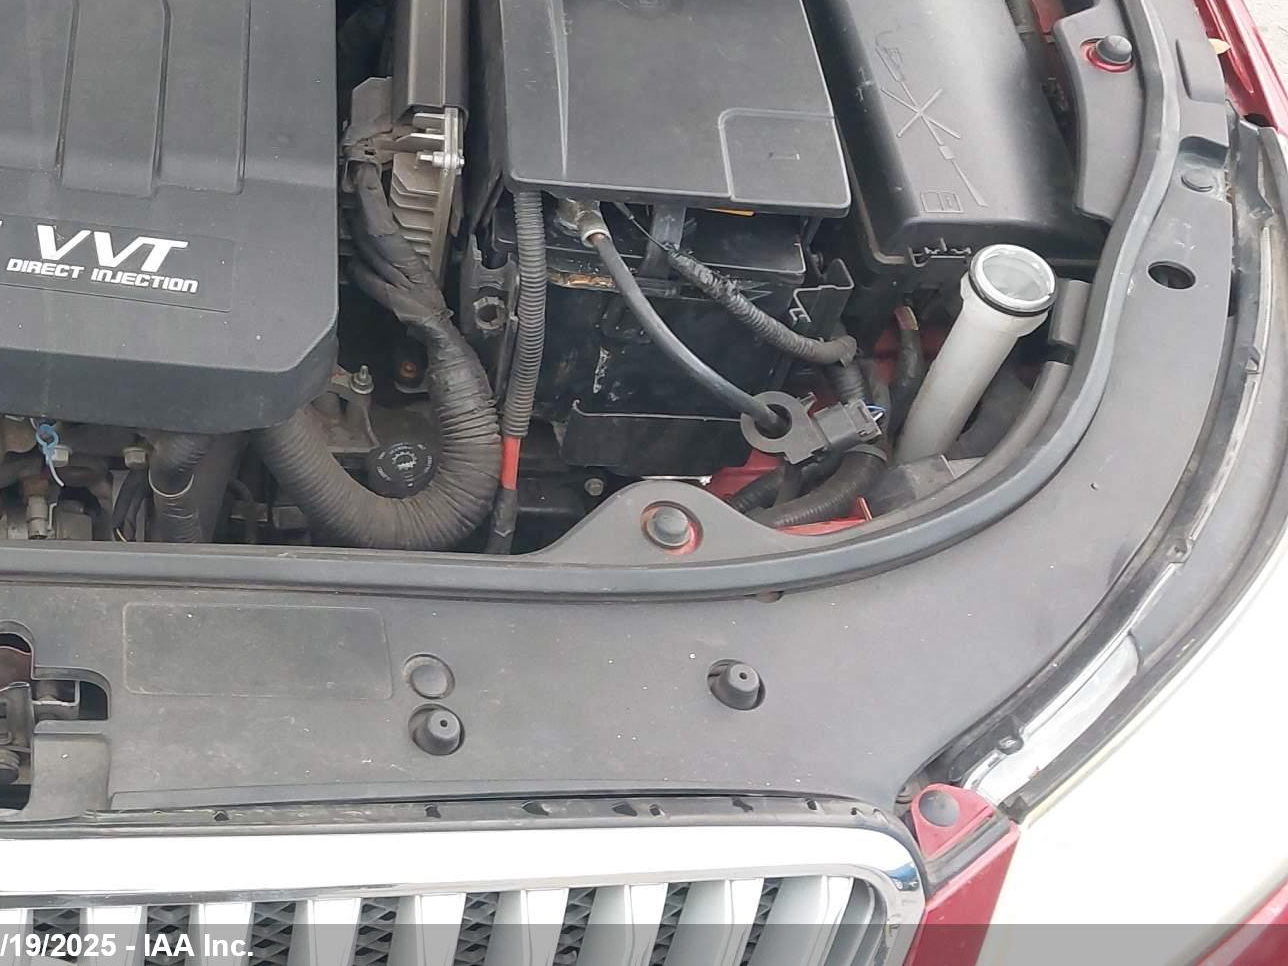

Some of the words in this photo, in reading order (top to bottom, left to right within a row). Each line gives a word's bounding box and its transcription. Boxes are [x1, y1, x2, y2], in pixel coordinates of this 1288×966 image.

[36, 224, 189, 273] VVT
[6, 258, 84, 280] DIRECT
[90, 268, 199, 293] INJECTION
